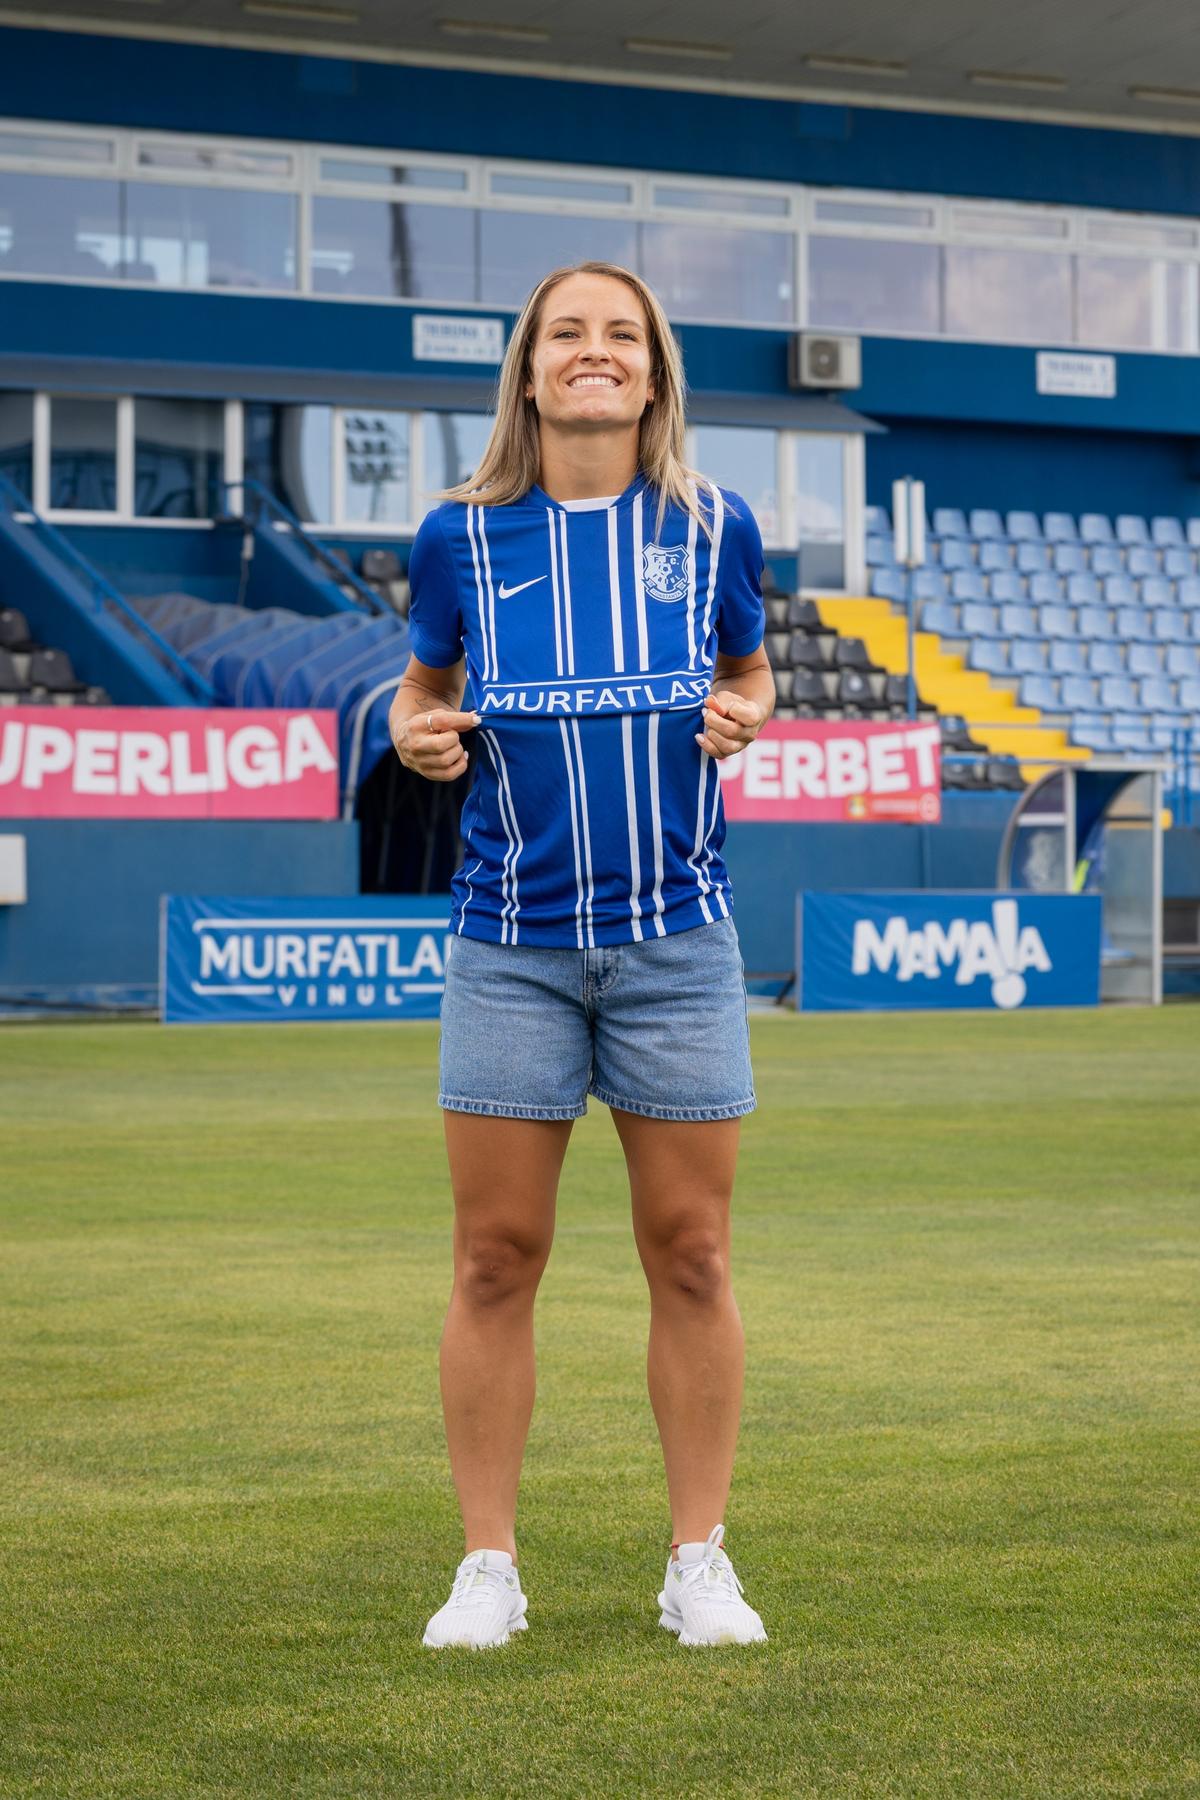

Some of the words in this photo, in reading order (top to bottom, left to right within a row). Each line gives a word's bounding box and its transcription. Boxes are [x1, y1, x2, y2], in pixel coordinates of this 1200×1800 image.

[481, 678, 711, 712] MURFATLAR
[200, 934, 452, 978] MURFATLA
[277, 984, 402, 1006] VINUL
